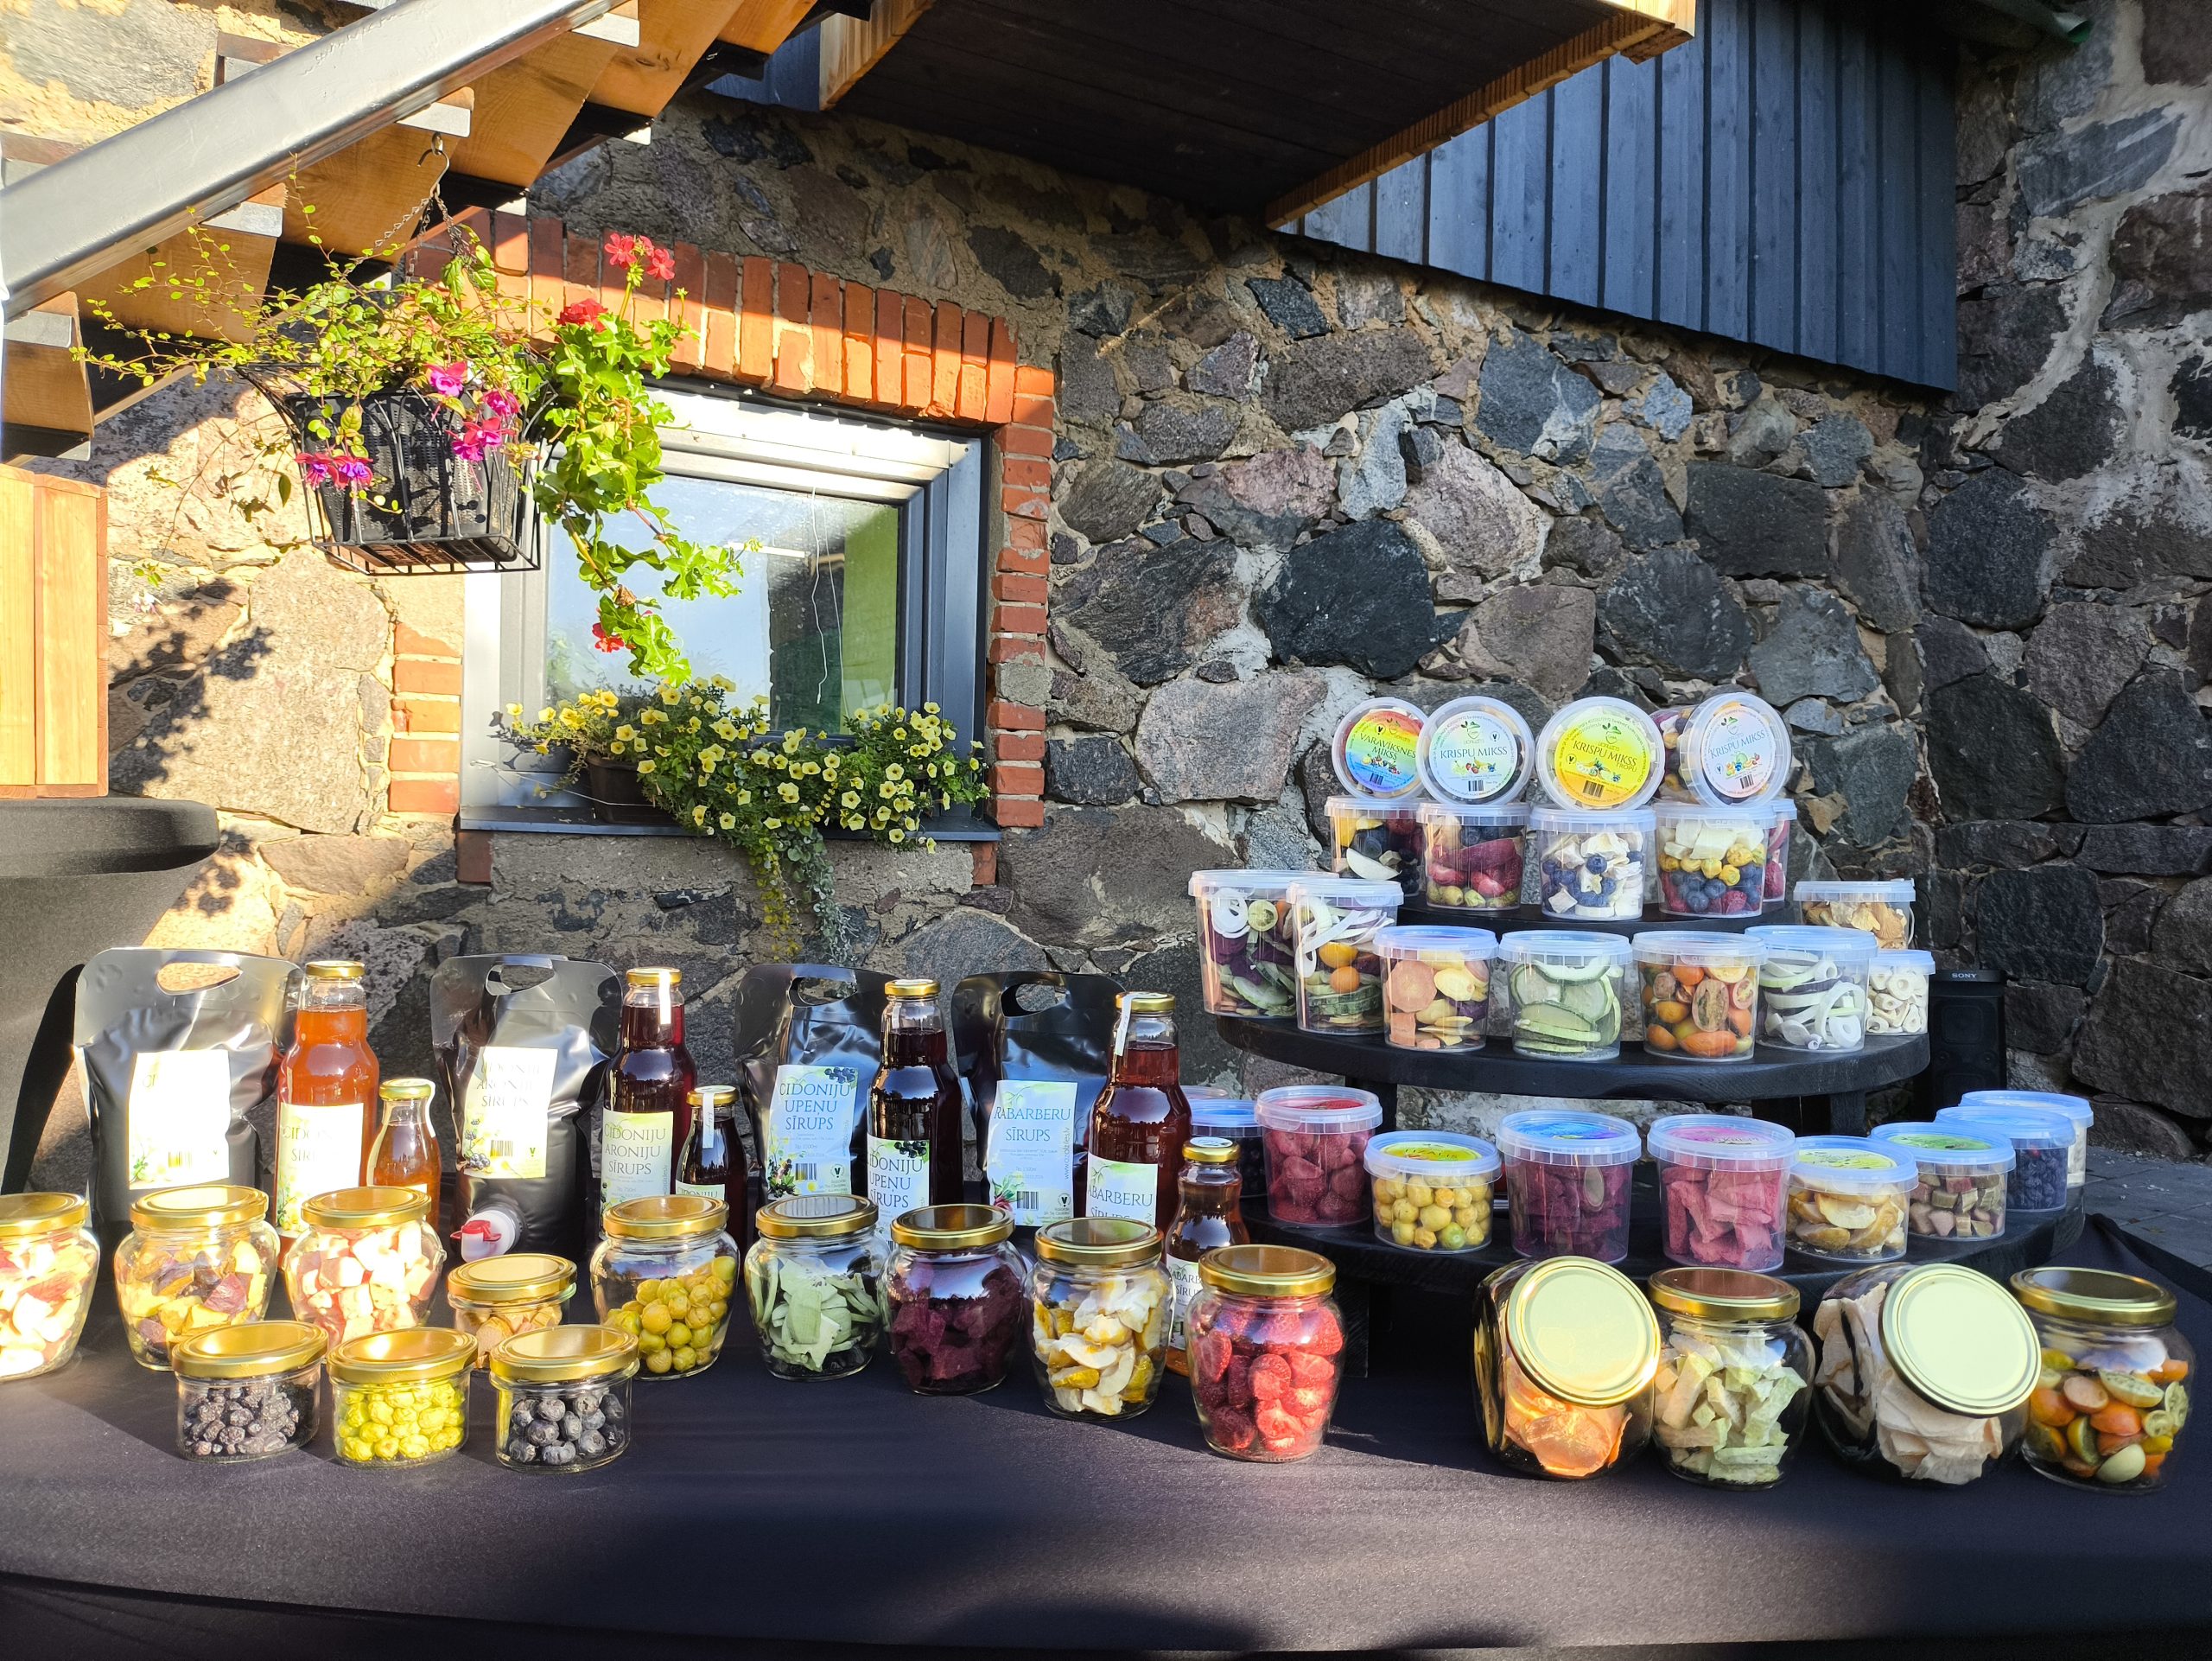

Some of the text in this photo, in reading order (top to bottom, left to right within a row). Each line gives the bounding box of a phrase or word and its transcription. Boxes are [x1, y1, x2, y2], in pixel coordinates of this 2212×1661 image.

[1440, 746, 1508, 759] KRISPU MIKSS
[1709, 741, 1740, 760] KRISPU
[1741, 729, 1766, 748] MIKSS
[1371, 746, 1398, 760] MIKSS
[1573, 740, 1608, 758] KRISPU
[1607, 752, 1637, 767] MIKSS
[785, 1099, 838, 1115] UPEŅU
[994, 1106, 1071, 1121] RABARBERU
[785, 1116, 834, 1130] SĪRUPS
[605, 1123, 667, 1142] CIDONIJU
[1005, 1126, 1051, 1142] SĪRUPS
[605, 1144, 661, 1160] ARONIJU
[608, 1161, 652, 1175] SĪRUPS
[868, 1153, 923, 1175] IDONIJU
[869, 1170, 911, 1193] UPEŅU
[870, 1189, 909, 1208] SĪRUPS
[1088, 1185, 1153, 1207] ABARBERU
